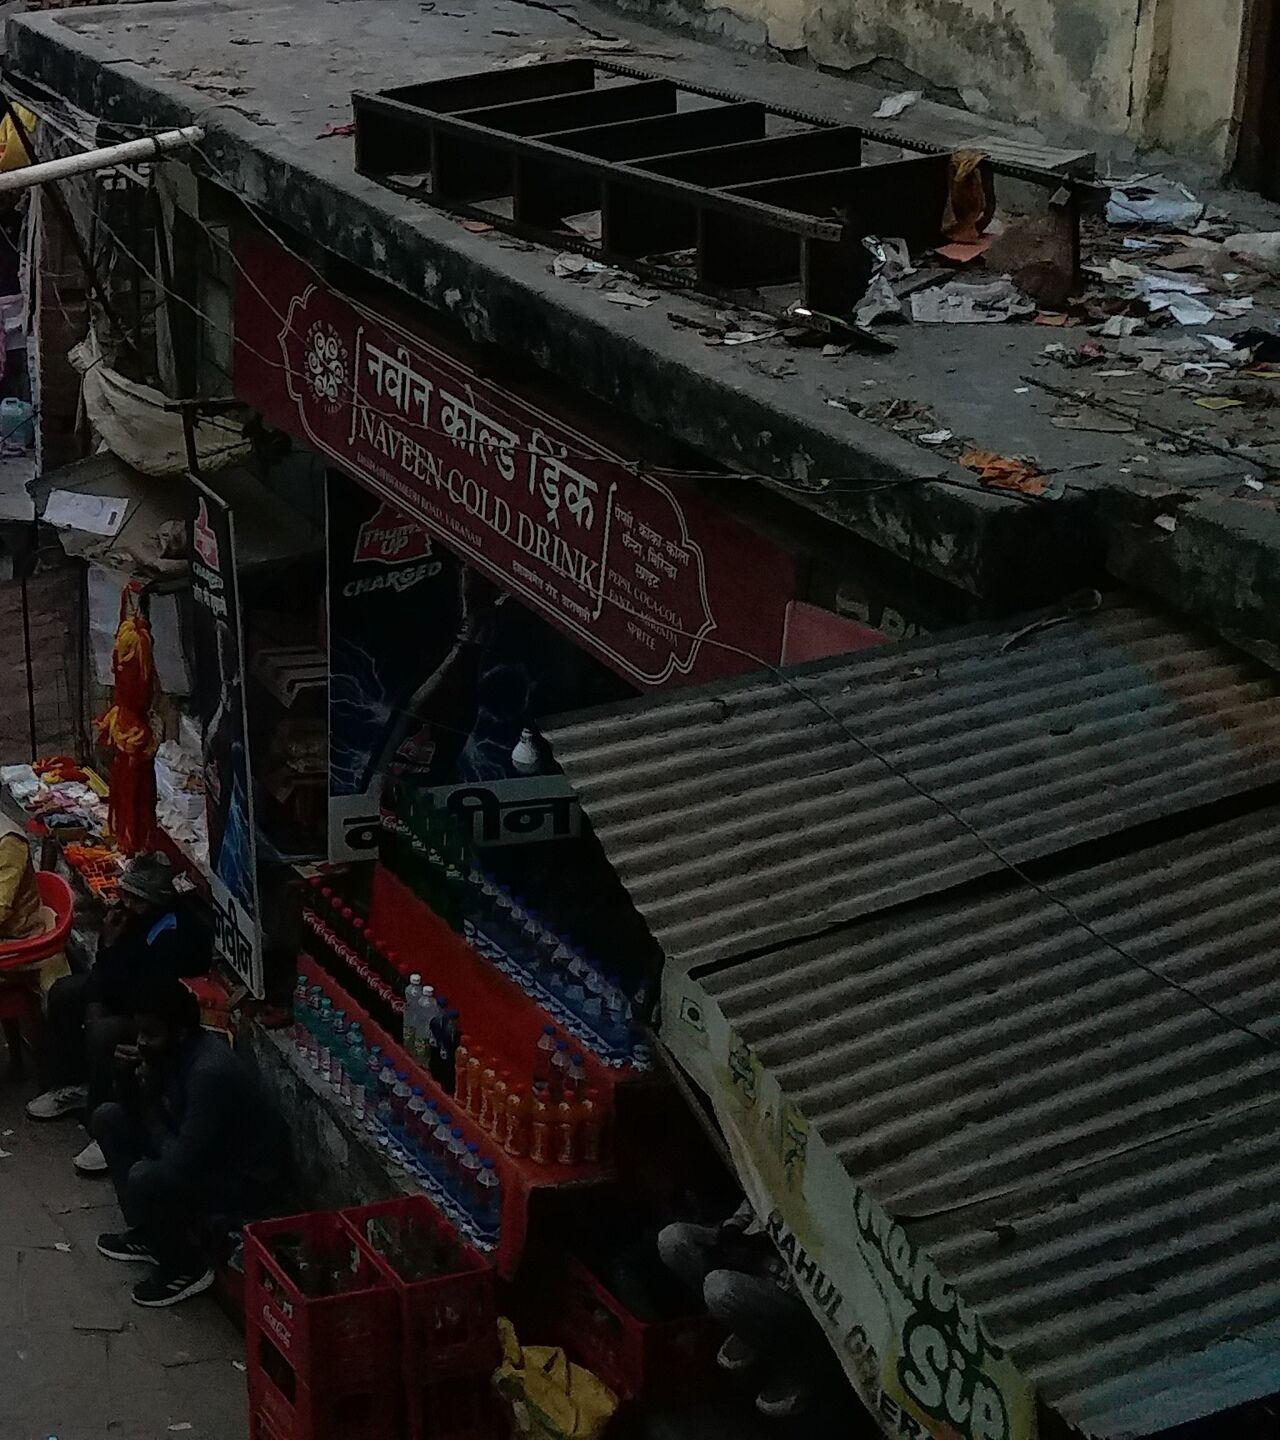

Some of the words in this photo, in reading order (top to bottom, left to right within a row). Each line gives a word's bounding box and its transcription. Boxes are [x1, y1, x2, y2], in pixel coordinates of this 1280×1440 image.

[359, 408, 443, 490] NAVEEN
[448, 468, 511, 538] COLD
[518, 511, 600, 599] DRINK
[366, 342, 433, 427] नवीन
[440, 384, 520, 481] कोल्ड
[528, 428, 599, 530] ड्रिंक
[342, 561, 443, 597] CHARGED
[768, 1210, 843, 1326] RAHUL
